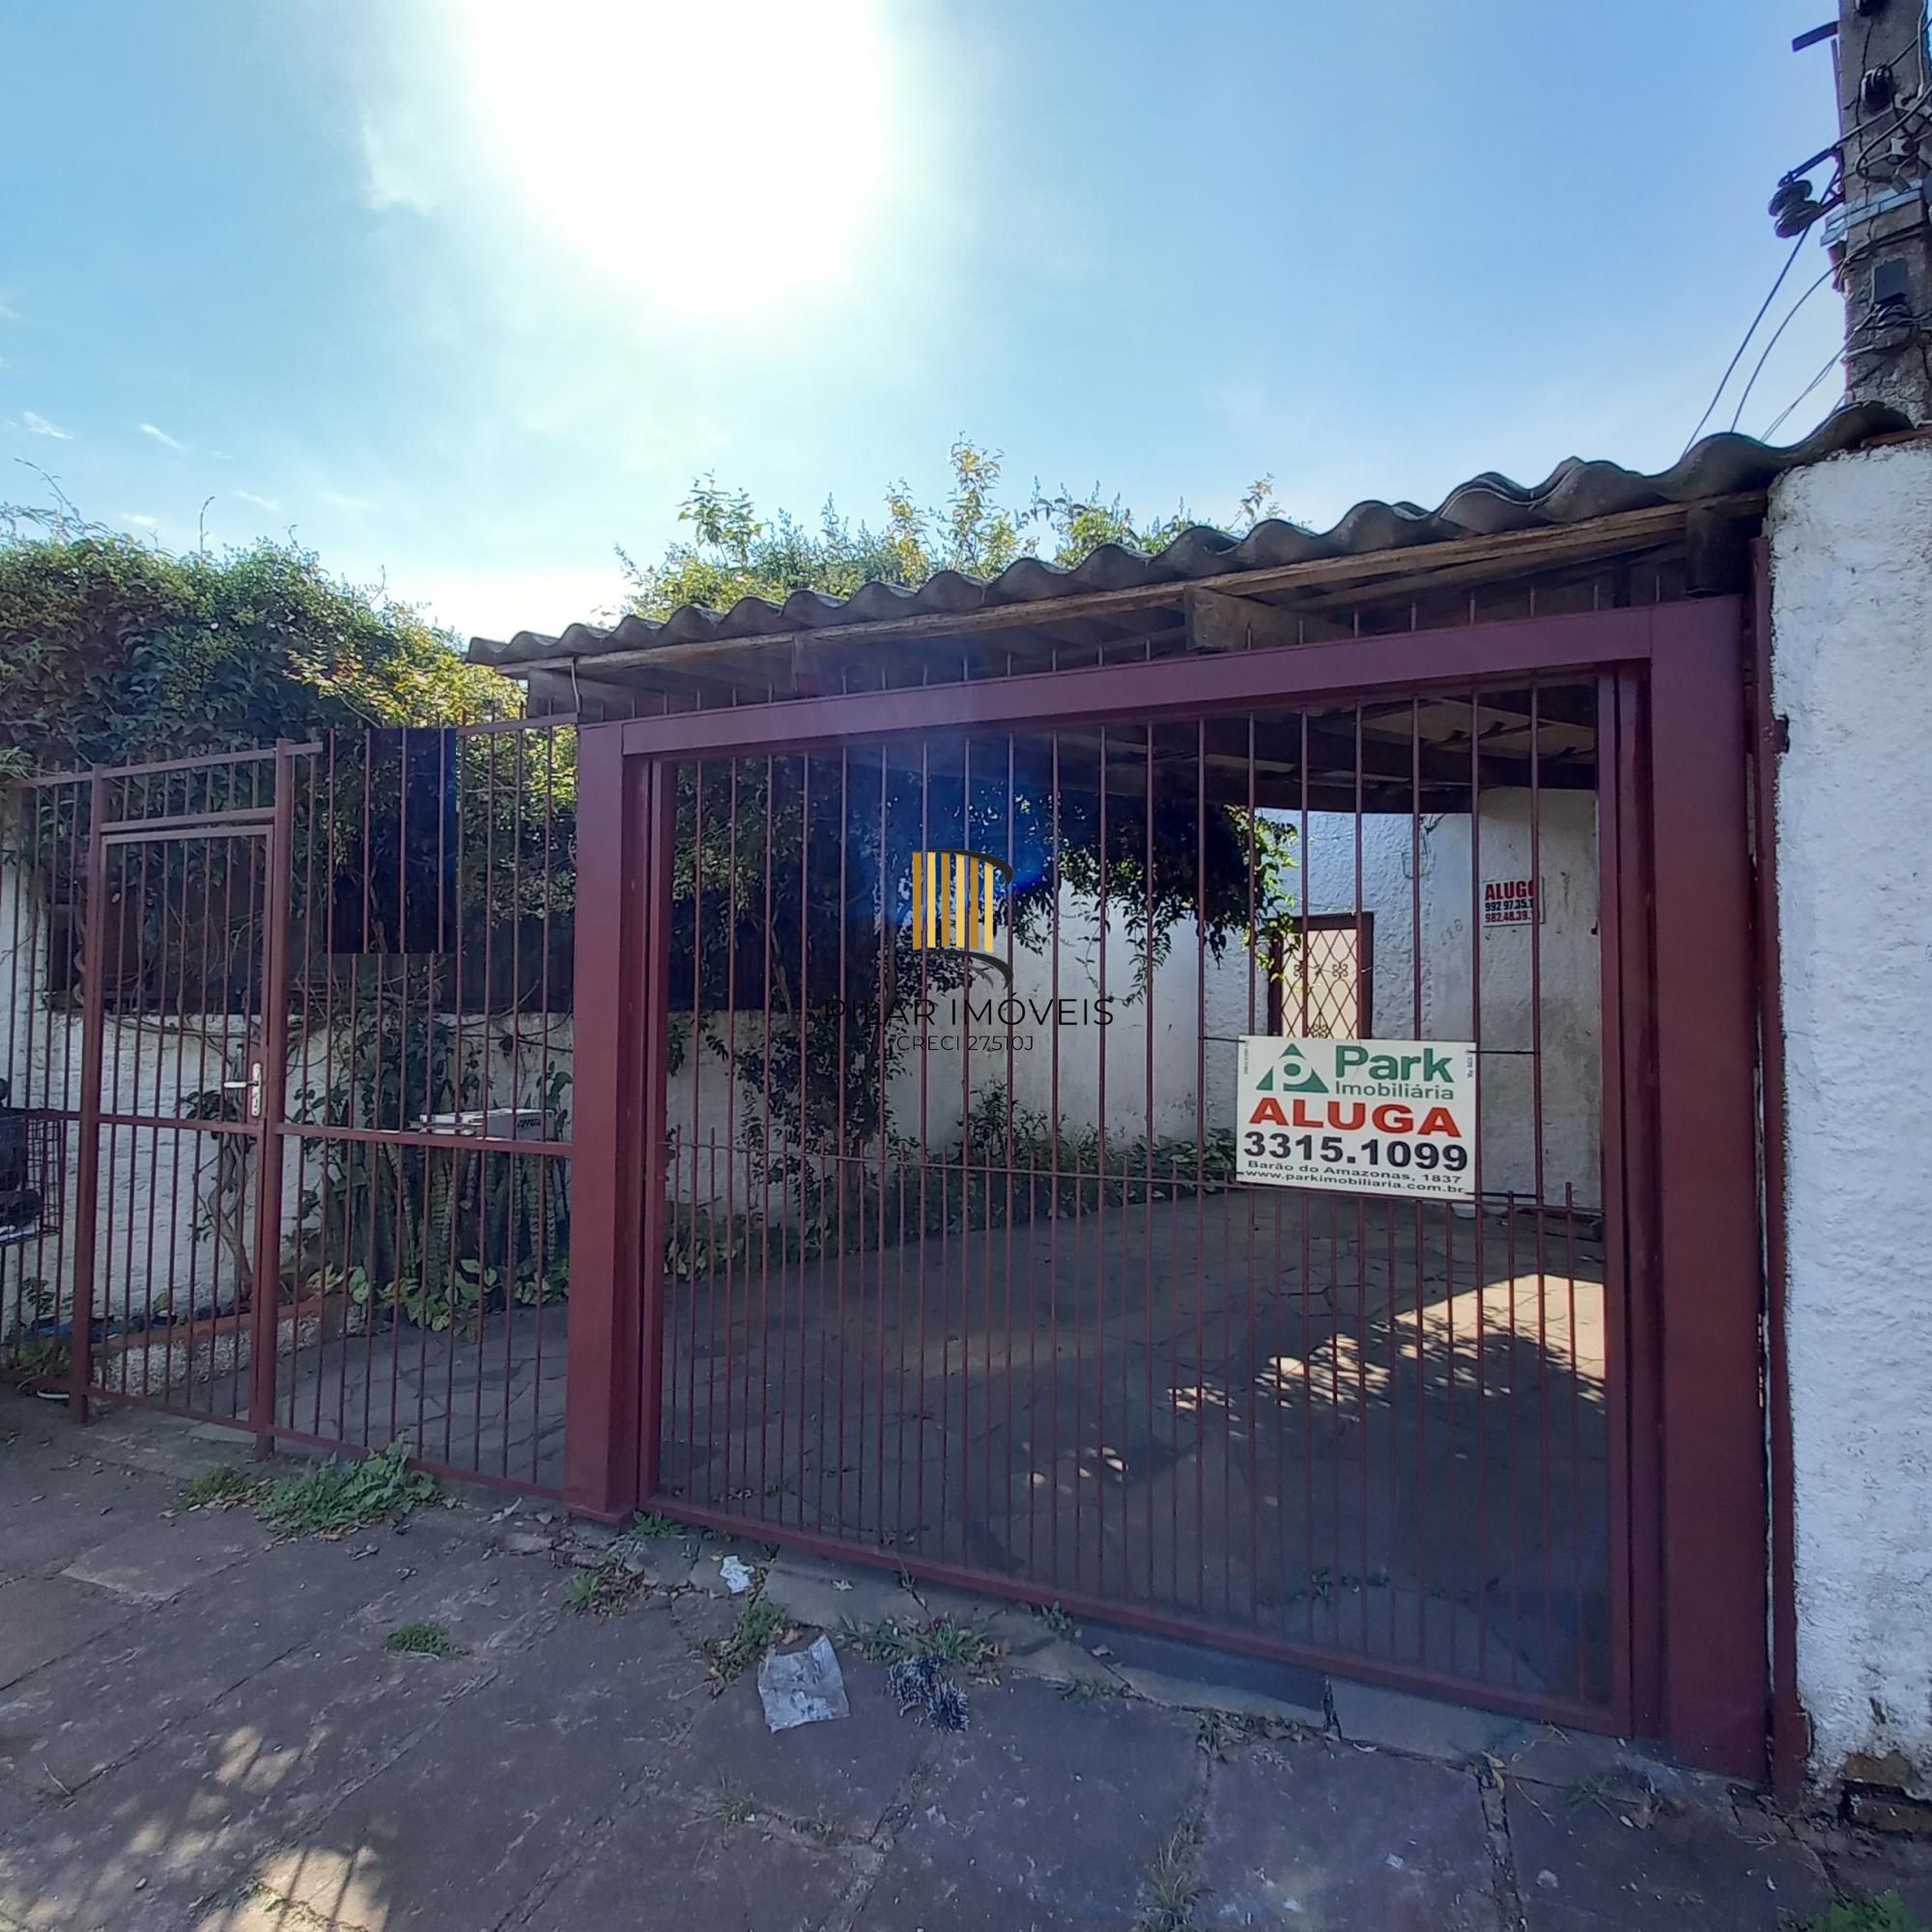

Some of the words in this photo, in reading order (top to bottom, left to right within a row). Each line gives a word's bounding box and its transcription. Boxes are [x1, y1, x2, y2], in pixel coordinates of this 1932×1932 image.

[1335, 1045, 1455, 1083] Park
[1335, 1081, 1454, 1100] Imobiliária
[1249, 1097, 1462, 1138] ALUGA
[1243, 1131, 1468, 1172] 3315.1099
[1244, 1169, 1464, 1194] www.parkimobiliaria.com.br
[1247, 1159, 1293, 1172] Barão
[1298, 1163, 1319, 1174] do
[1322, 1166, 1416, 1181] Amazonas,
[1422, 1174, 1463, 1184] 1837
